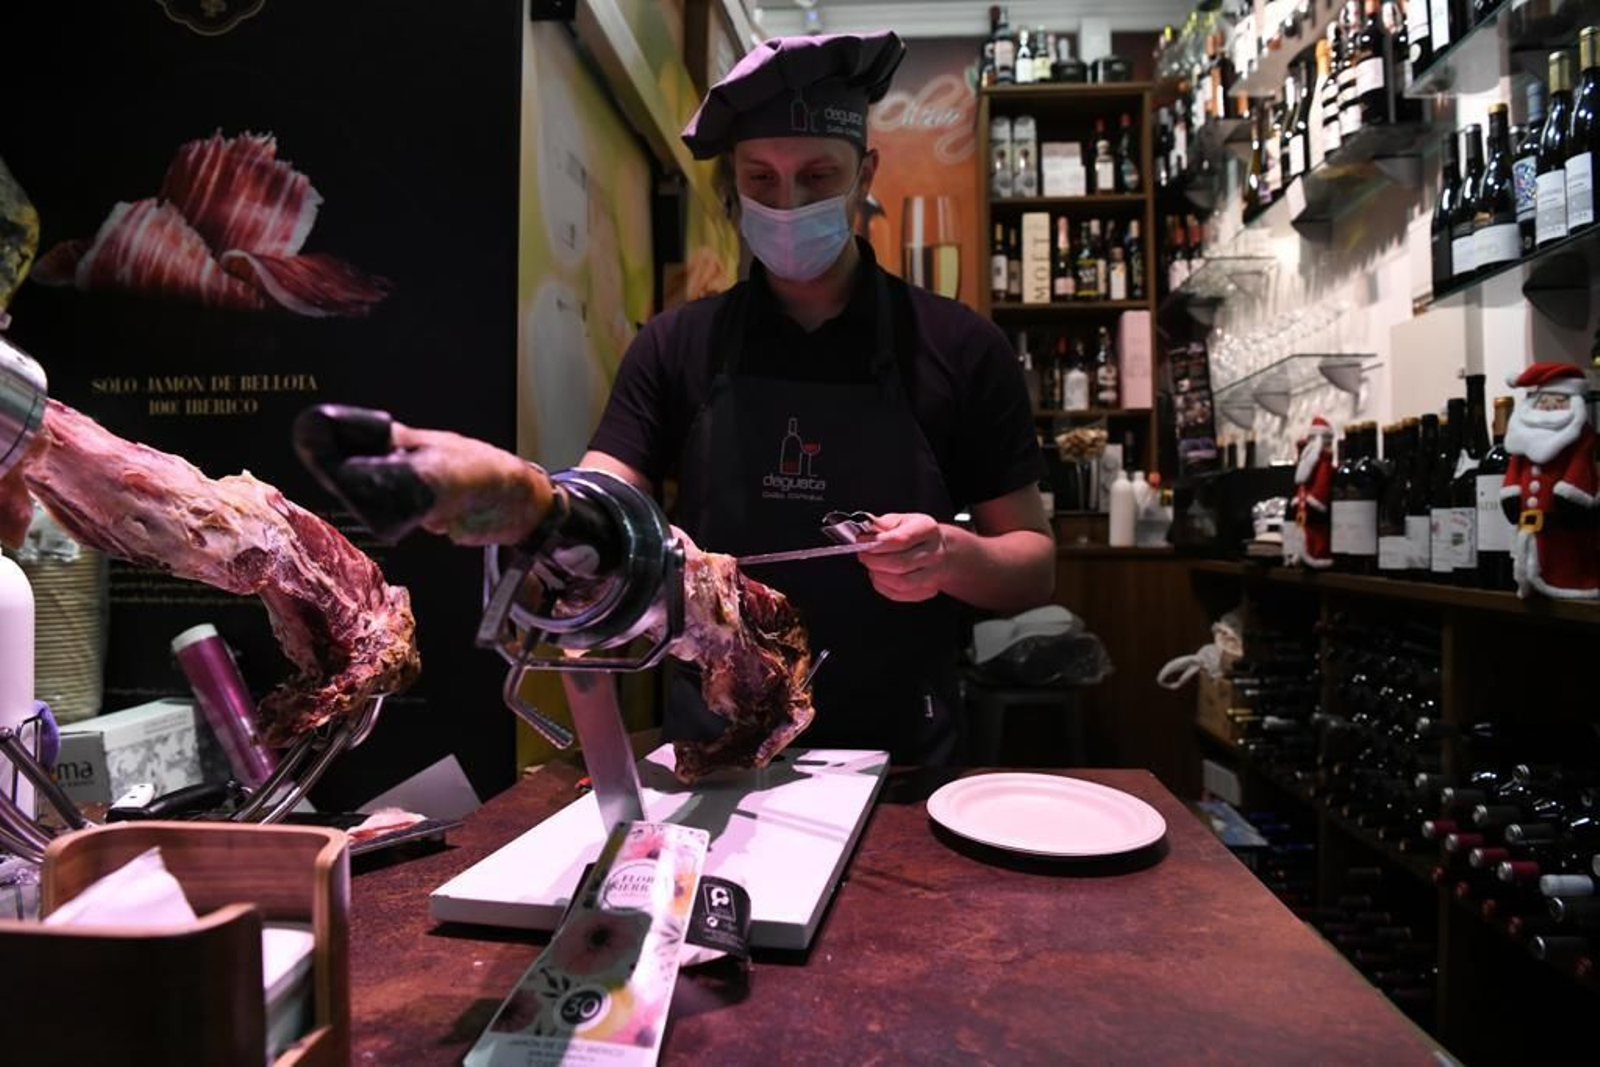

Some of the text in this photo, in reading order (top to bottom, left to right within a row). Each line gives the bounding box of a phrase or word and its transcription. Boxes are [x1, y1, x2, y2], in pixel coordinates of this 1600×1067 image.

[211, 374, 235, 392] DE
[240, 374, 318, 391] BELLOTA
[762, 472, 826, 491] degusta
